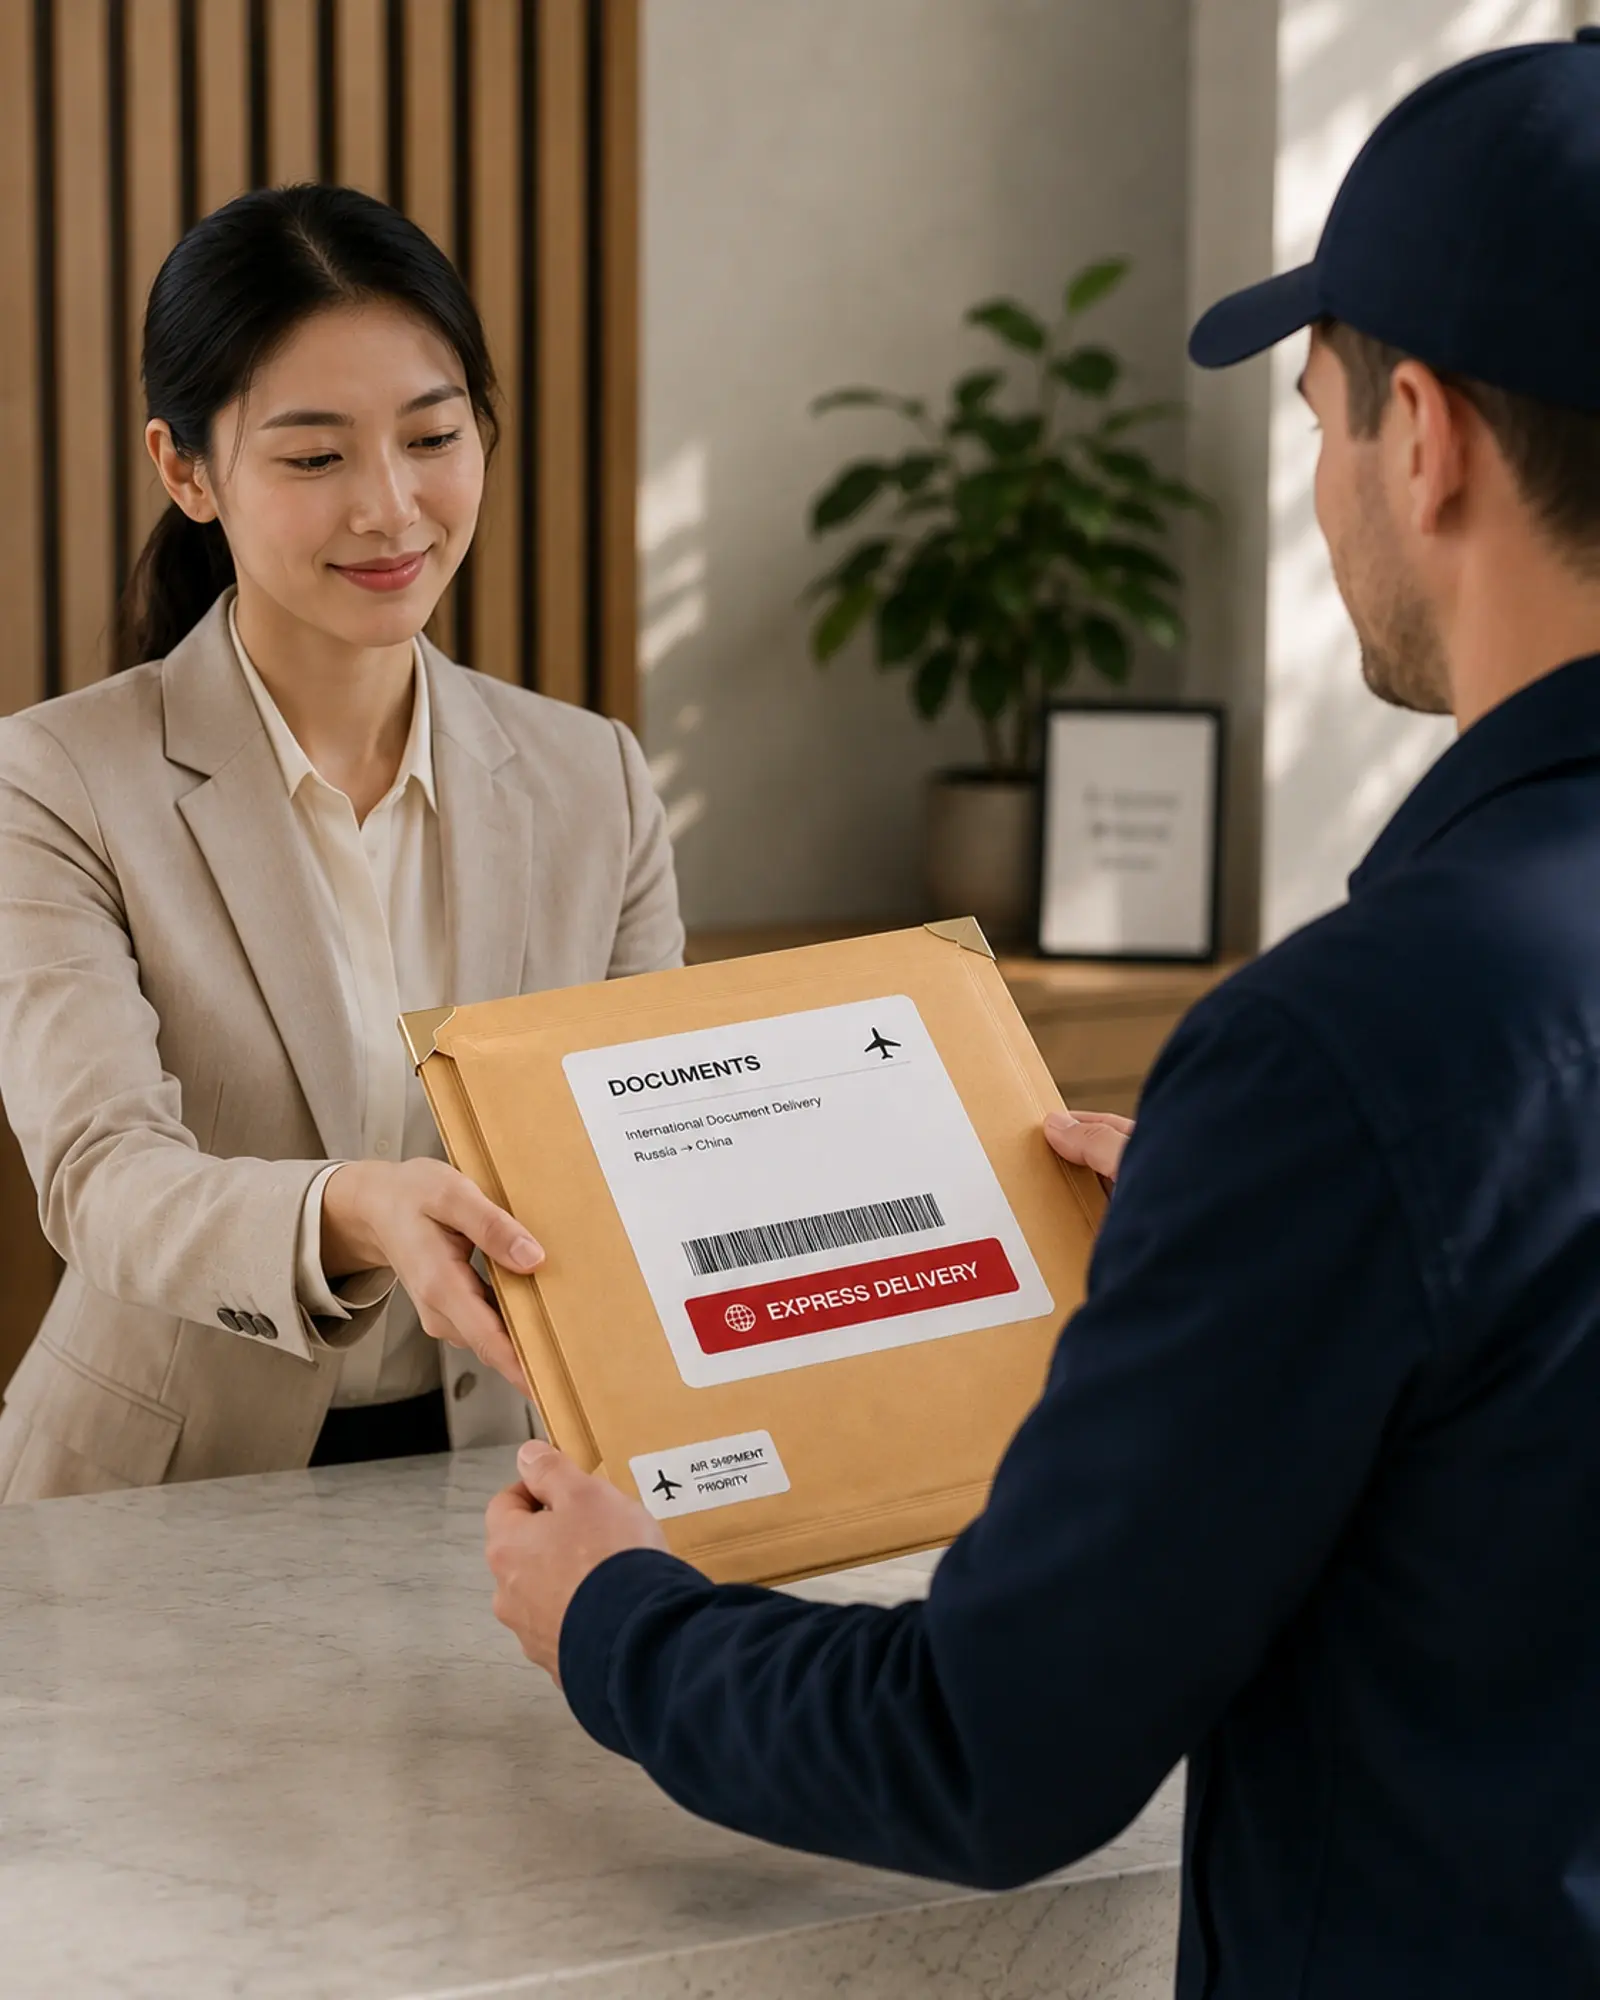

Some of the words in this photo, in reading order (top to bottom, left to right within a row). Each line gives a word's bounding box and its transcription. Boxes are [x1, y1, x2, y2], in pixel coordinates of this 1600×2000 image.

[608, 1055, 761, 1097] DOCUMENTS
[625, 1118, 704, 1141] International
[707, 1105, 771, 1126] Document
[773, 1095, 822, 1115] Delivery
[634, 1145, 677, 1163] Russia
[695, 1135, 733, 1151] China
[766, 1285, 871, 1321] EXPRESS
[873, 1261, 979, 1299] DELIVERY
[690, 1460, 709, 1474] AIR
[697, 1474, 749, 1494] PRIORITY
